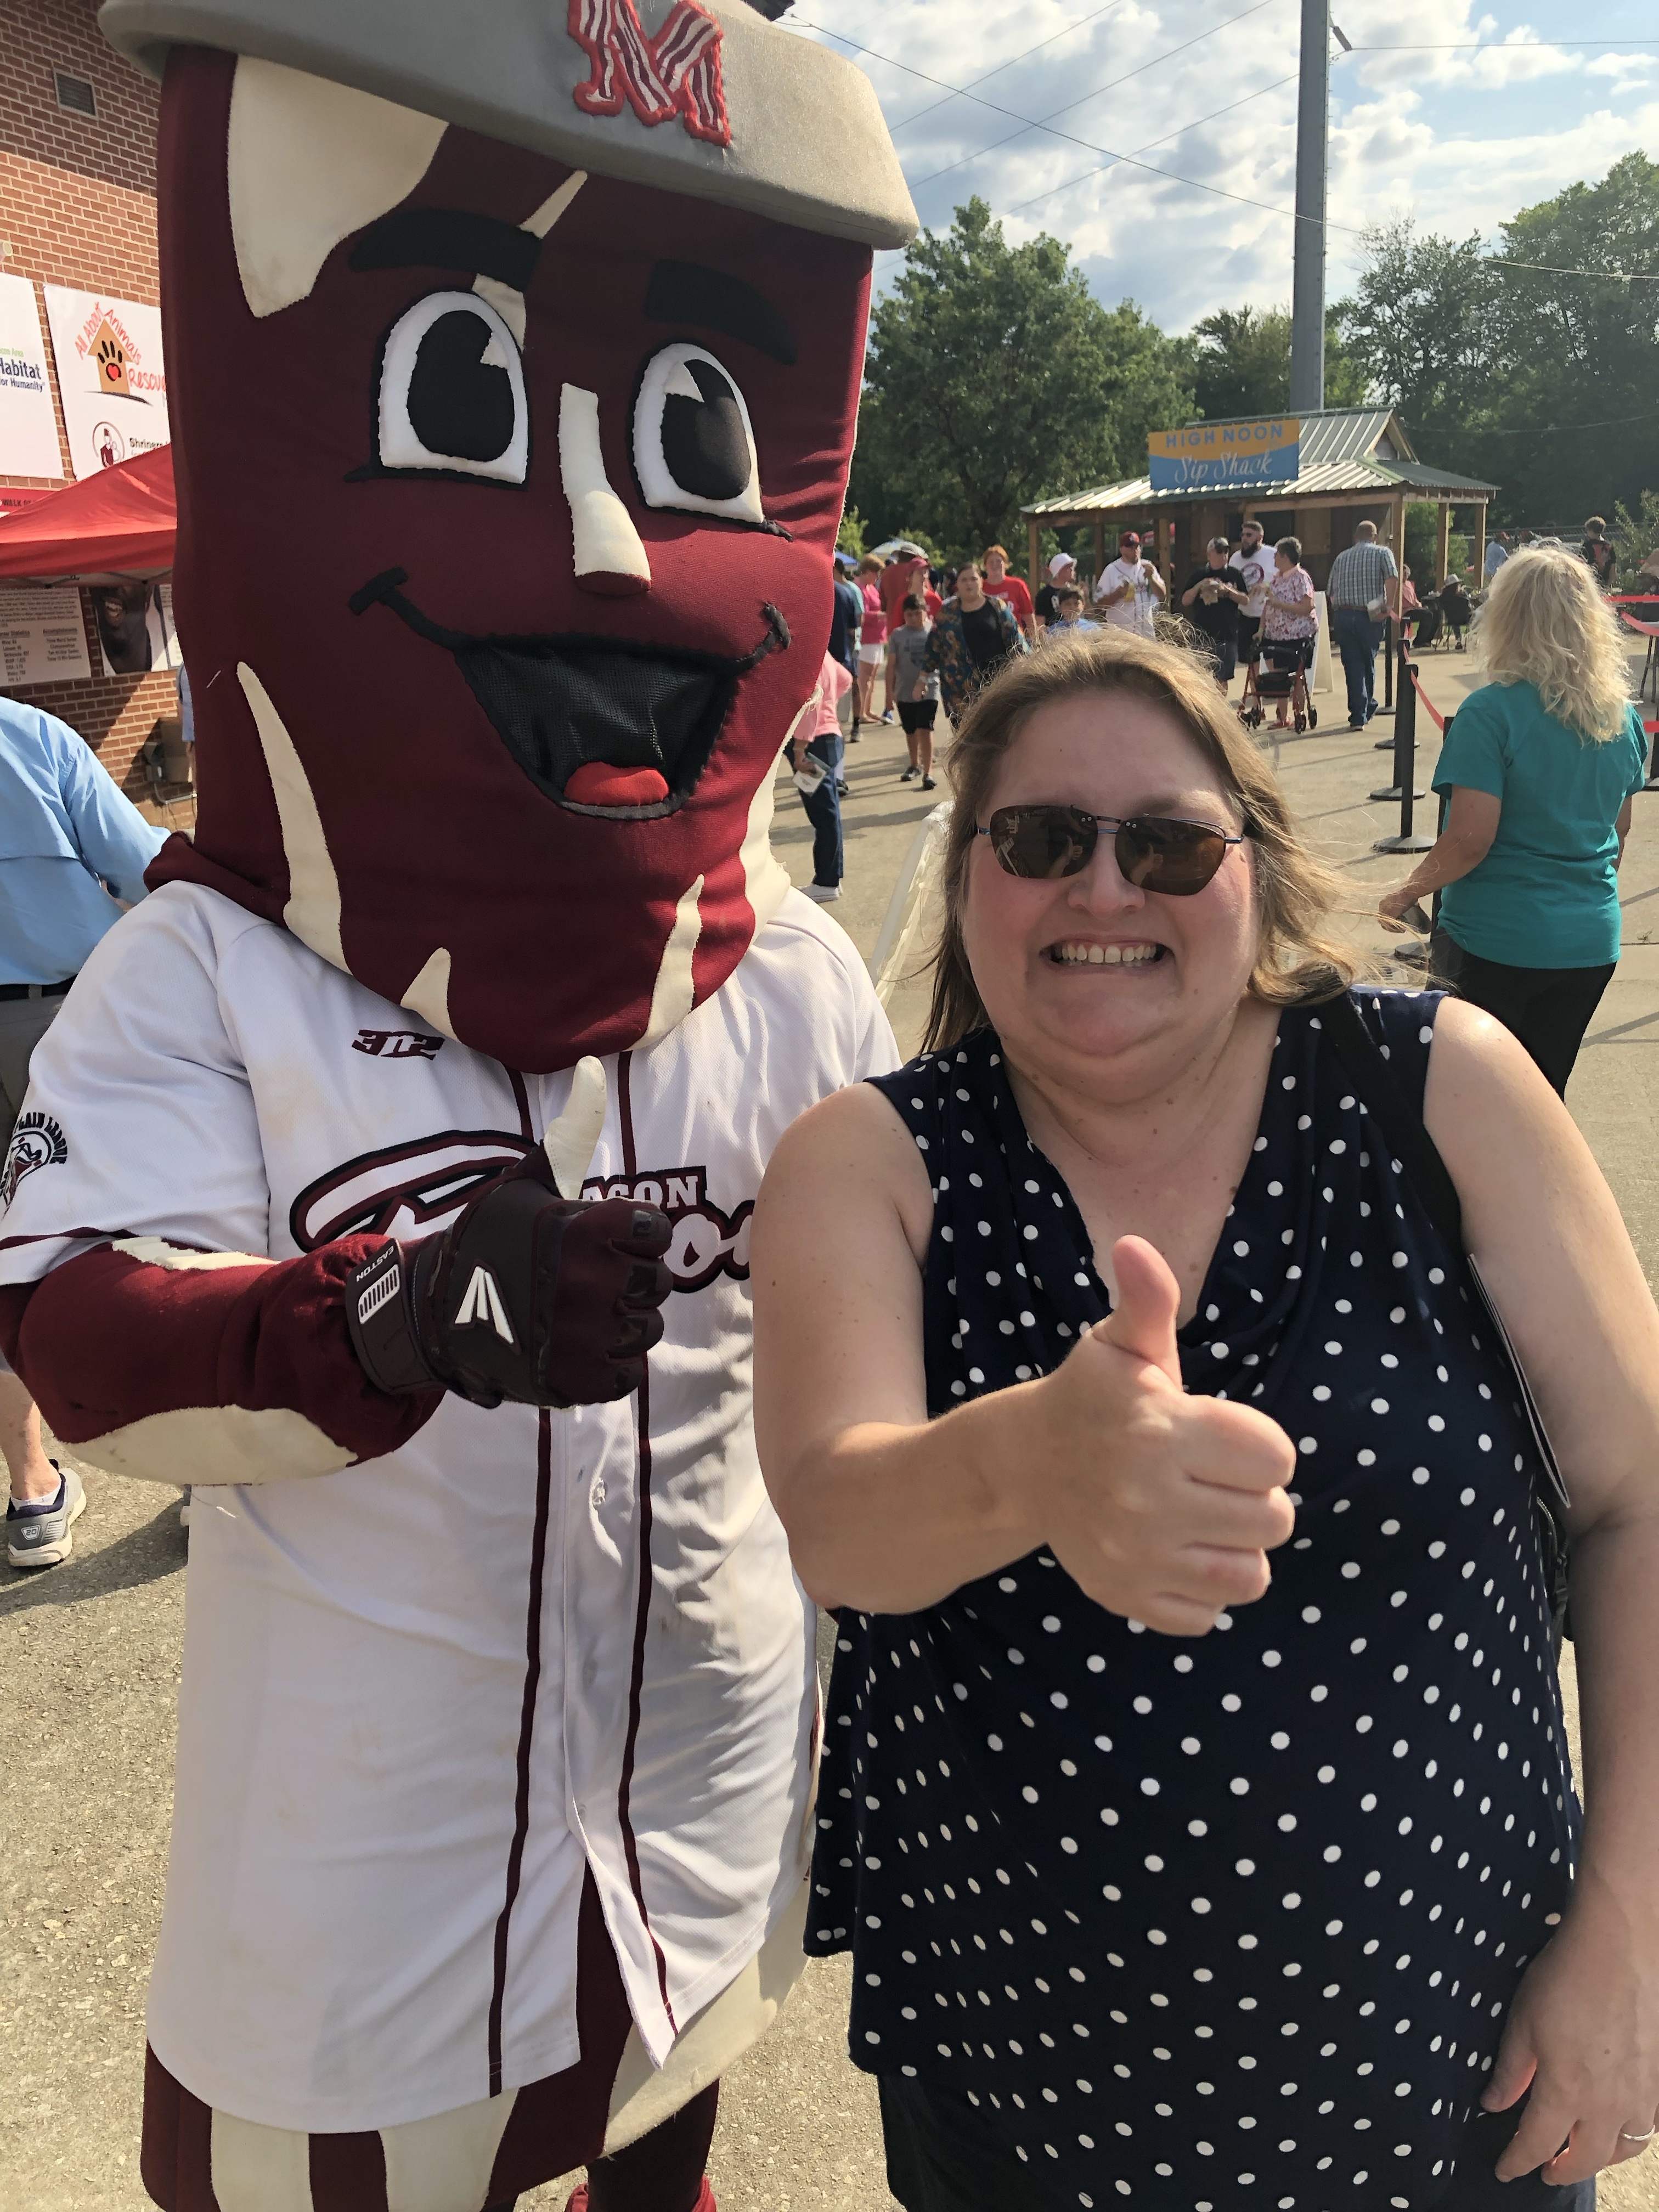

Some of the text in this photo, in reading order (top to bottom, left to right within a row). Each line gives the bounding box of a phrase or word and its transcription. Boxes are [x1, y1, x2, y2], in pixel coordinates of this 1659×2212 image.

[567, 0, 731, 147] M
[83, 302, 104, 345] About
[104, 309, 142, 366] Animals
[128, 368, 166, 391] Rescue
[1166, 424, 1283, 448] HIGH NOON
[1174, 448, 1273, 486] Sip Shack
[356, 1245, 394, 1282] EASTON
